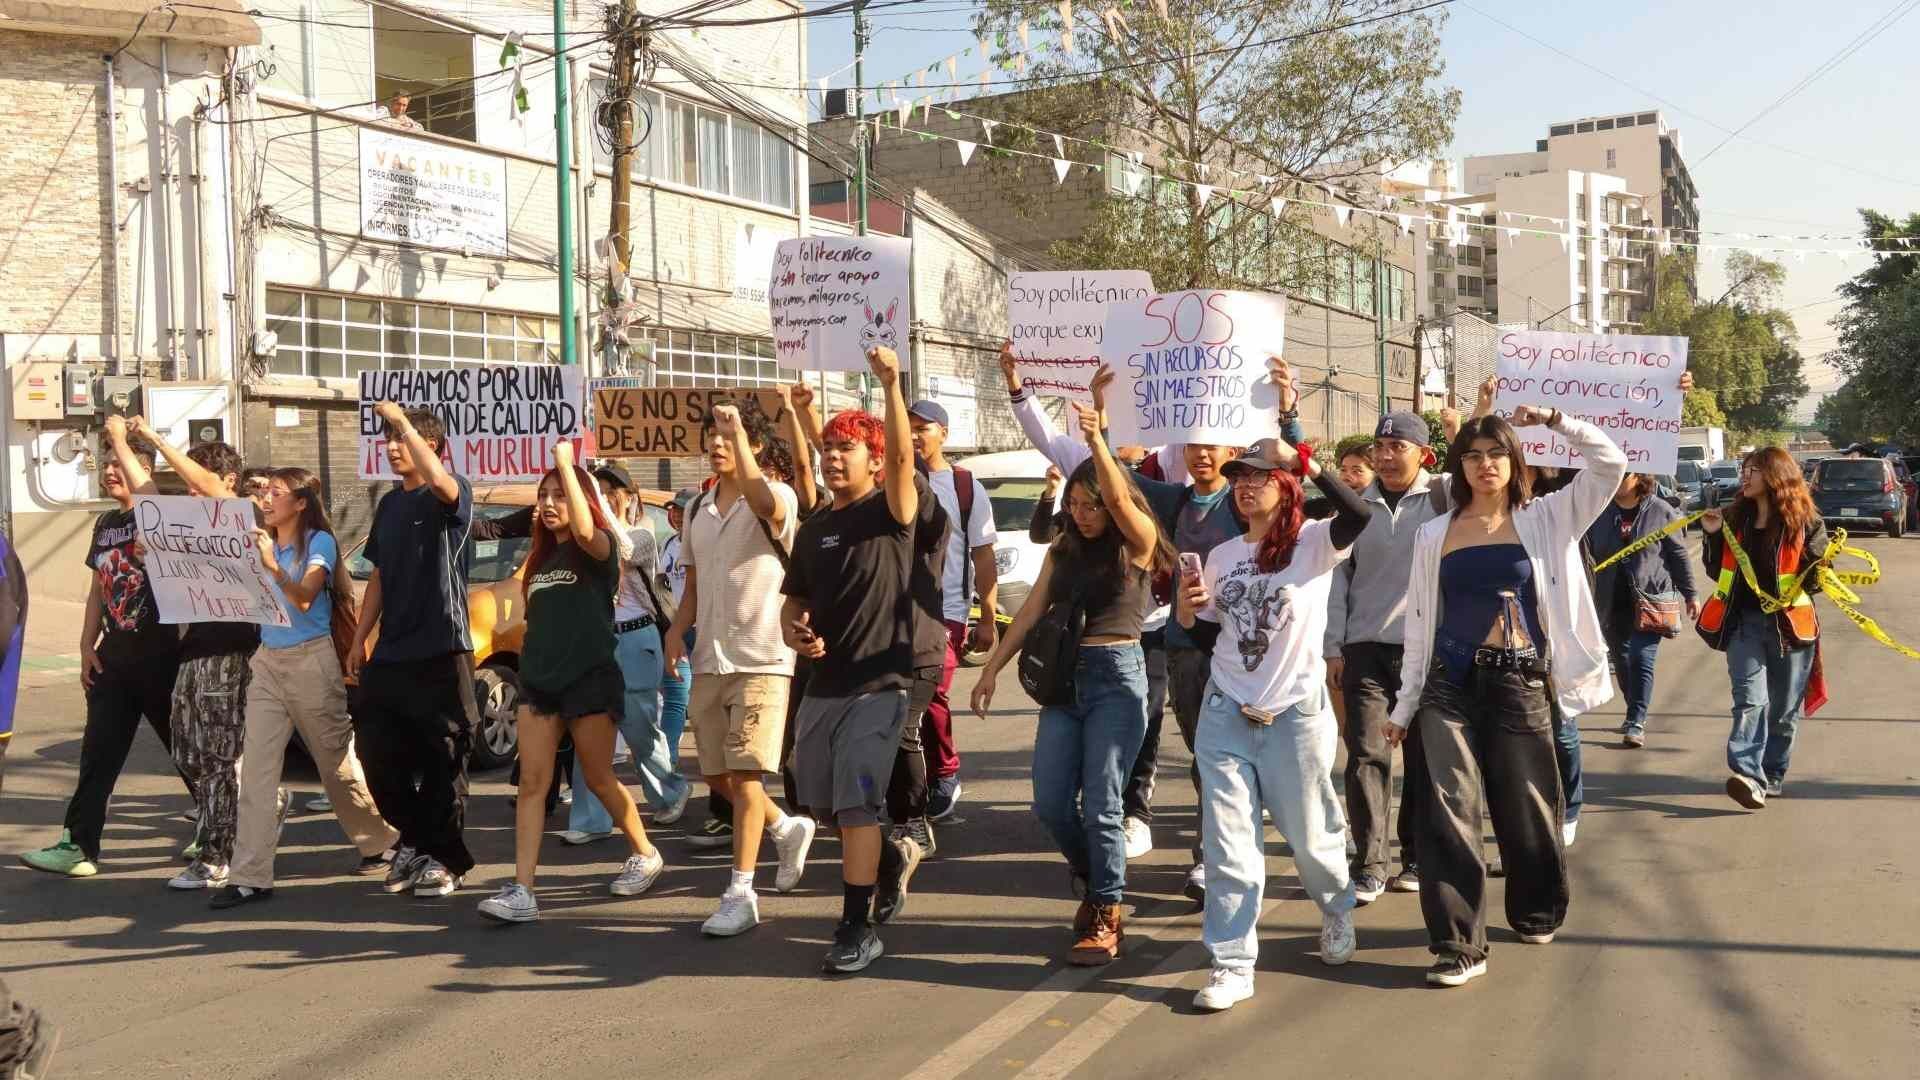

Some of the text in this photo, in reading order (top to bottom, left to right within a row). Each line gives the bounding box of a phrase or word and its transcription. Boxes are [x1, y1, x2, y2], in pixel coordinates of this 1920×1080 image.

[376, 151, 491, 187] VACANTES
[801, 265, 832, 287] tener
[838, 270, 881, 286] apoyo
[1010, 276, 1045, 309] Soy
[1012, 322, 1104, 347] porque exij
[1141, 292, 1234, 347] SOS
[1128, 351, 1161, 379] SIN
[1164, 345, 1243, 373] RECURSOS
[1501, 333, 1671, 370] Soy politécnico
[360, 366, 565, 402] LUCHAMOS POR UNA
[1134, 375, 1247, 409] SIN MAESTROS
[1494, 377, 1664, 409] por convicción,
[464, 403, 489, 436] DE
[491, 402, 578, 436] CALIDAD.
[598, 391, 634, 420] V6
[641, 391, 679, 421] NO
[1140, 403, 1246, 430] SIN FUTURO
[1567, 408, 1681, 434] ircunstancias
[599, 424, 689, 452] DEJAR
[1550, 434, 1566, 456] lo
